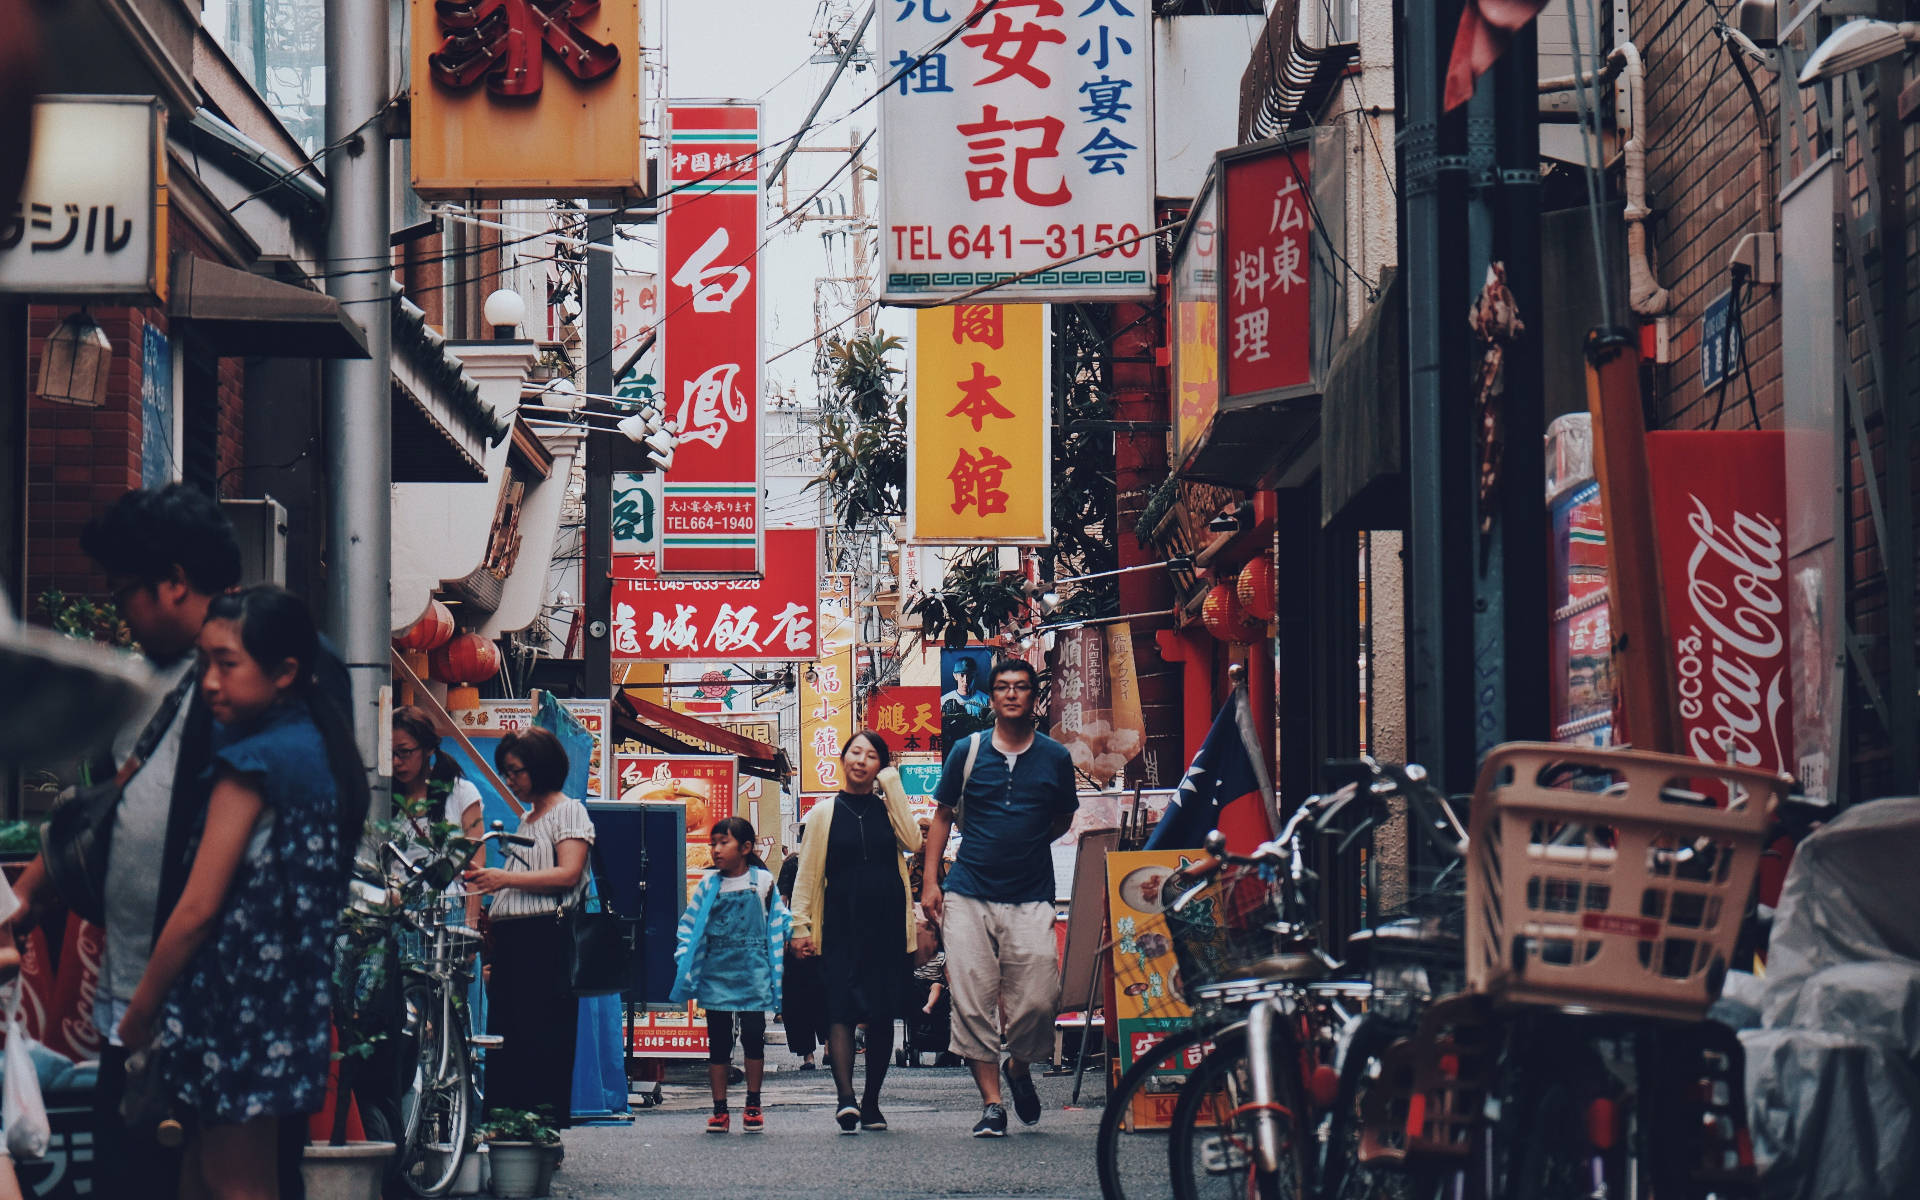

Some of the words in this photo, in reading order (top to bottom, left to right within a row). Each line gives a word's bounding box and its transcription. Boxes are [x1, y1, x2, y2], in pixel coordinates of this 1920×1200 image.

[956, 0, 1072, 207] 安記
[671, 152, 755, 173] 中国料理
[1268, 176, 1306, 294] 広東
[671, 228, 752, 449] 台鳳
[1233, 246, 1270, 363] 料理
[945, 305, 1016, 517] 閣本館
[667, 516, 753, 530] TEL664-1940
[669, 500, 752, 513] 大小宴会承ります
[820, 596, 848, 608] マイ!
